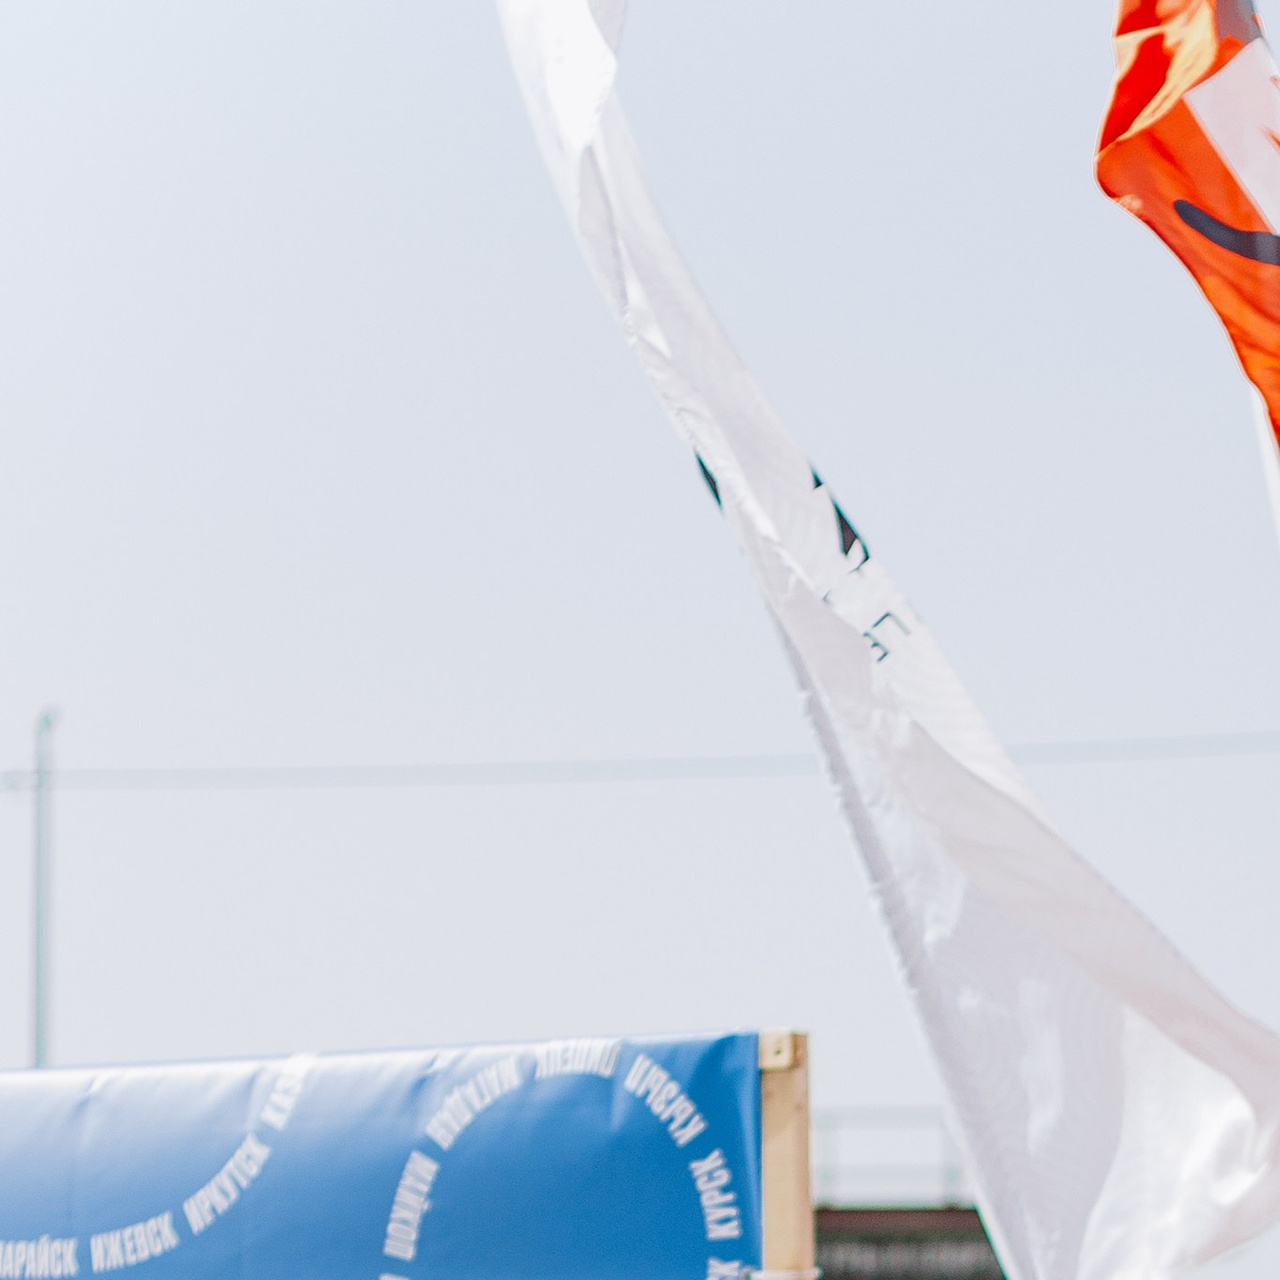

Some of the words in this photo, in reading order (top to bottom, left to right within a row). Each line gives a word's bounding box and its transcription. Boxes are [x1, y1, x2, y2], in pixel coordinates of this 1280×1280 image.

[625, 1054, 707, 1148] КЫЗЫЛ
[90, 1211, 181, 1274] ИЖЕВСК
[182, 1134, 272, 1236] ИРКУТСК
[383, 1150, 440, 1261] МАЙКОП
[690, 1150, 741, 1241] КУРСК
